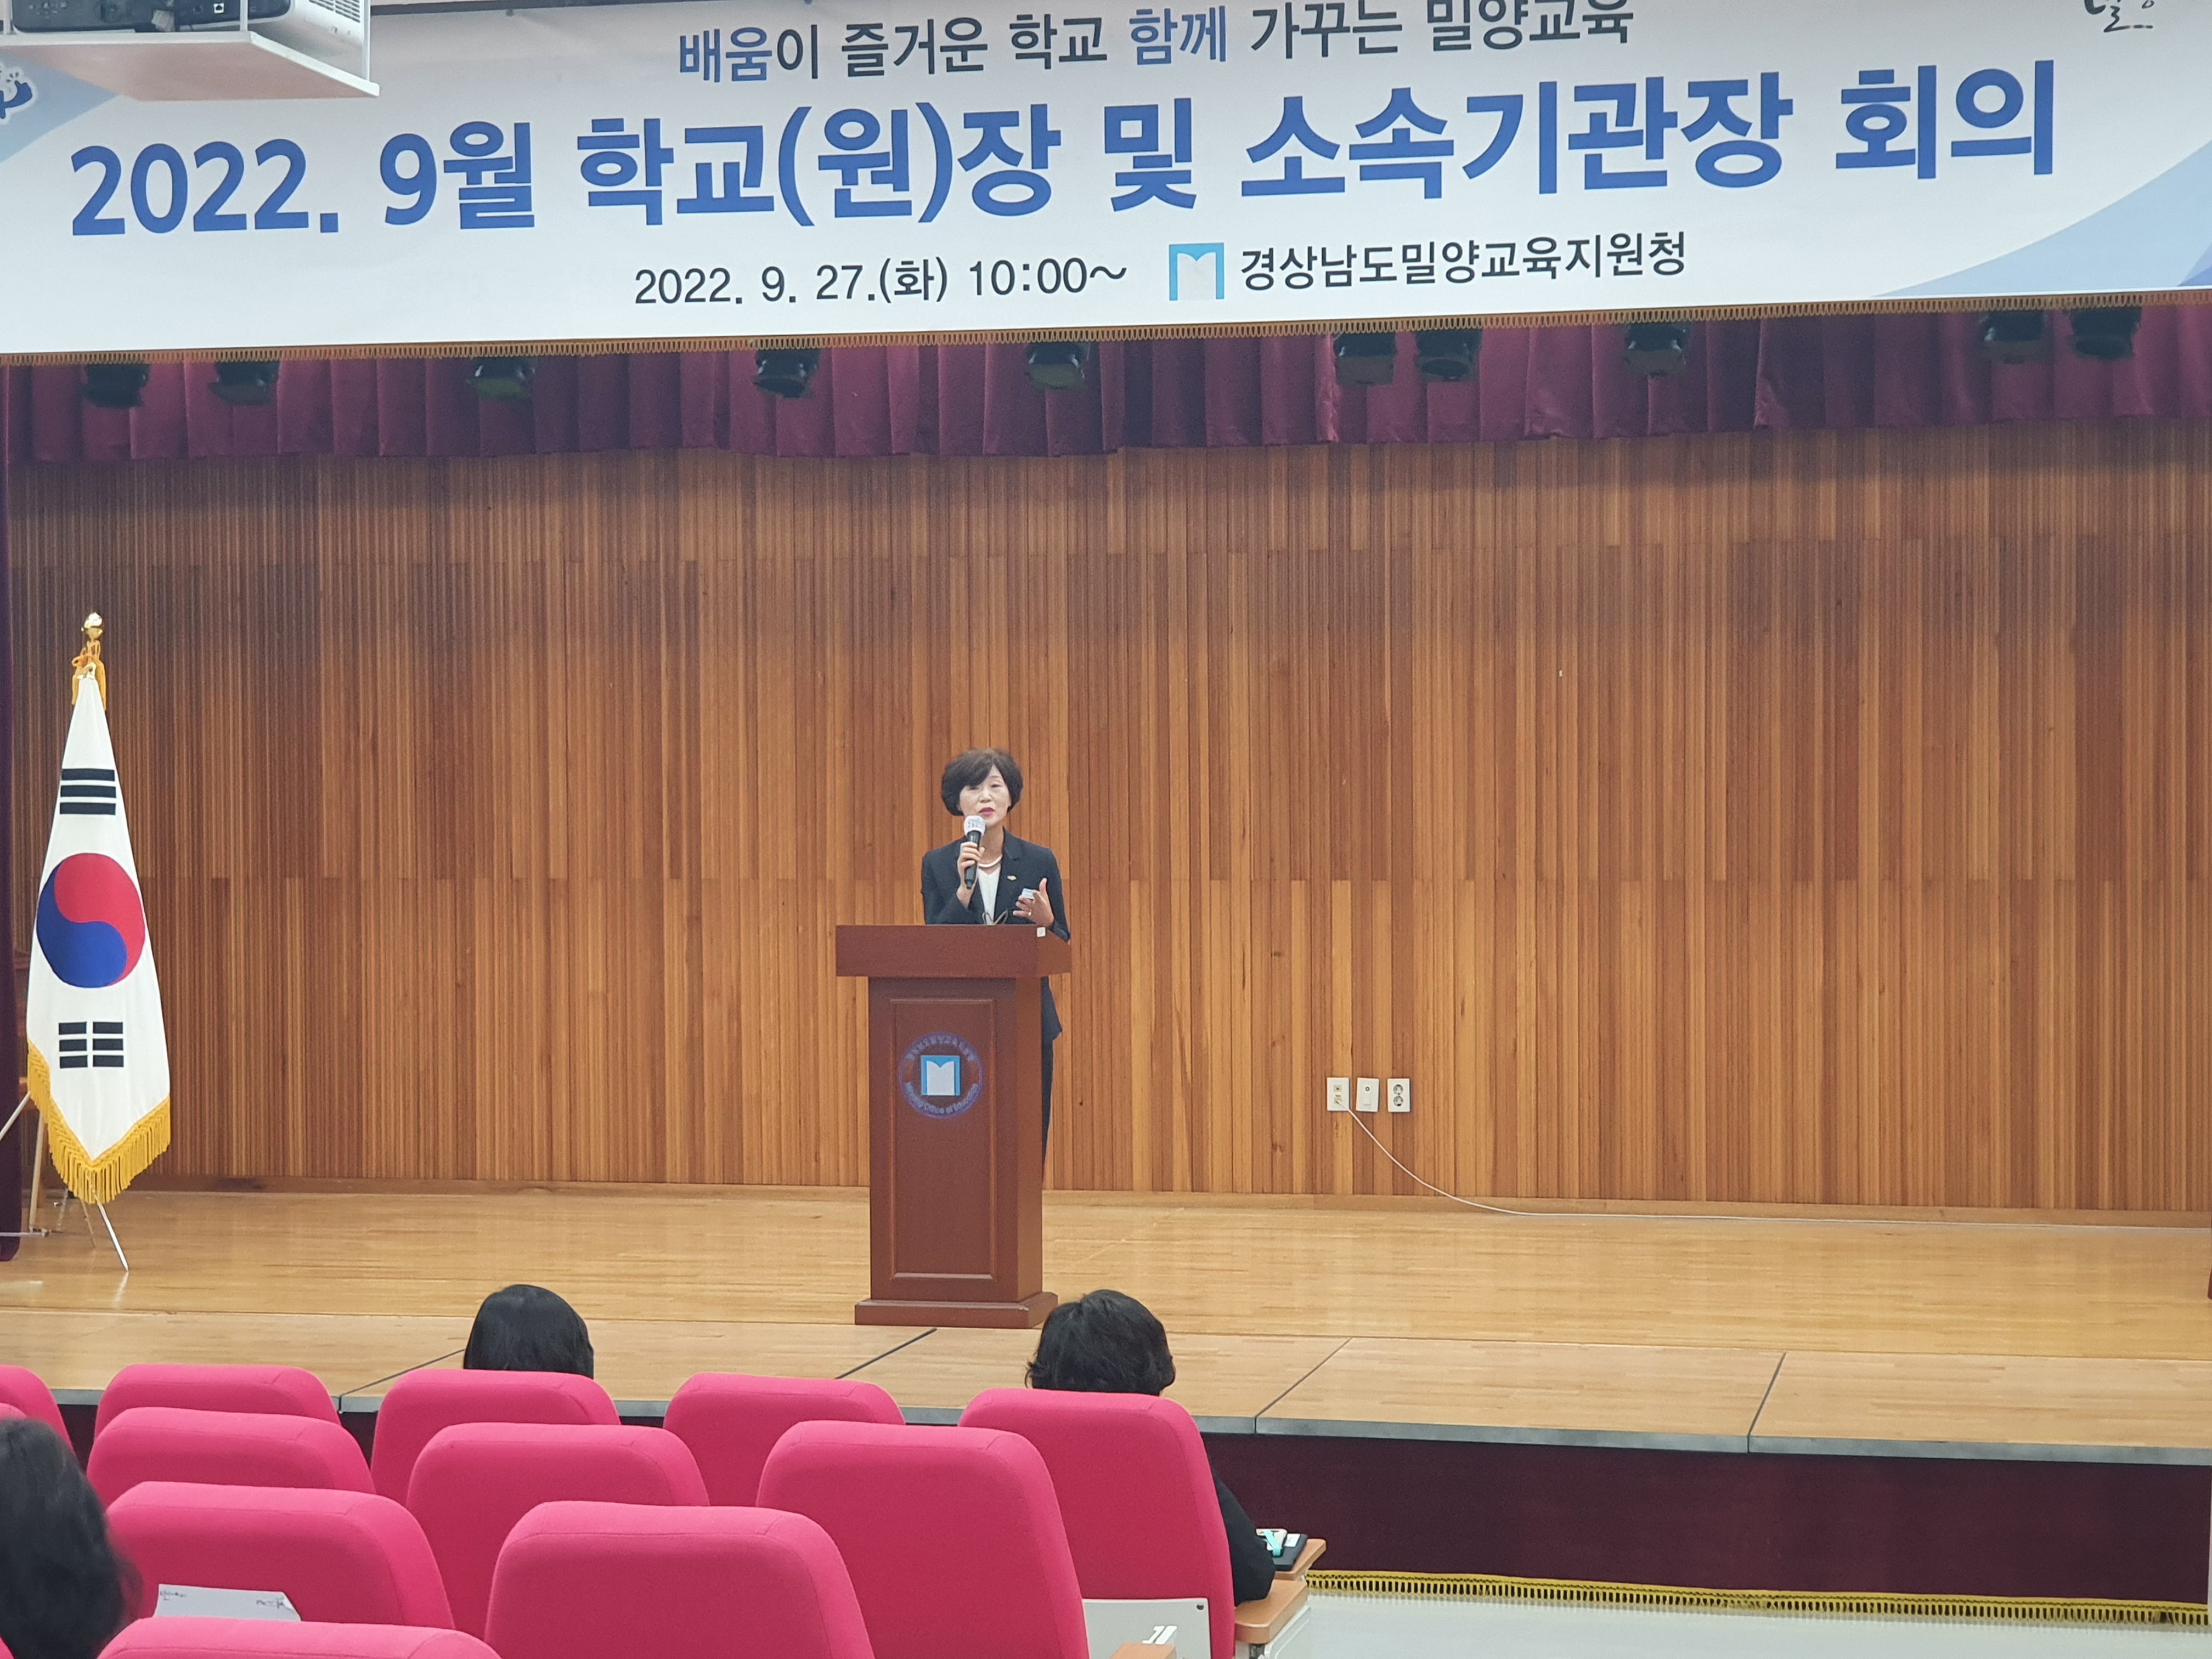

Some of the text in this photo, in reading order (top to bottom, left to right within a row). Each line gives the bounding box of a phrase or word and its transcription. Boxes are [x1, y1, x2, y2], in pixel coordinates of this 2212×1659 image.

[680, 0, 1634, 83] 배움이 즐거운 학교 함께 가꾸는 밀양교육
[71, 59, 2054, 236] 2022. 9월 학교(원)장 및 소속기관장 회의
[635, 257, 1127, 304] 2022. 9. 27.(화) 10:00~
[1241, 232, 1684, 291] 경상남도밀양교육지원청
